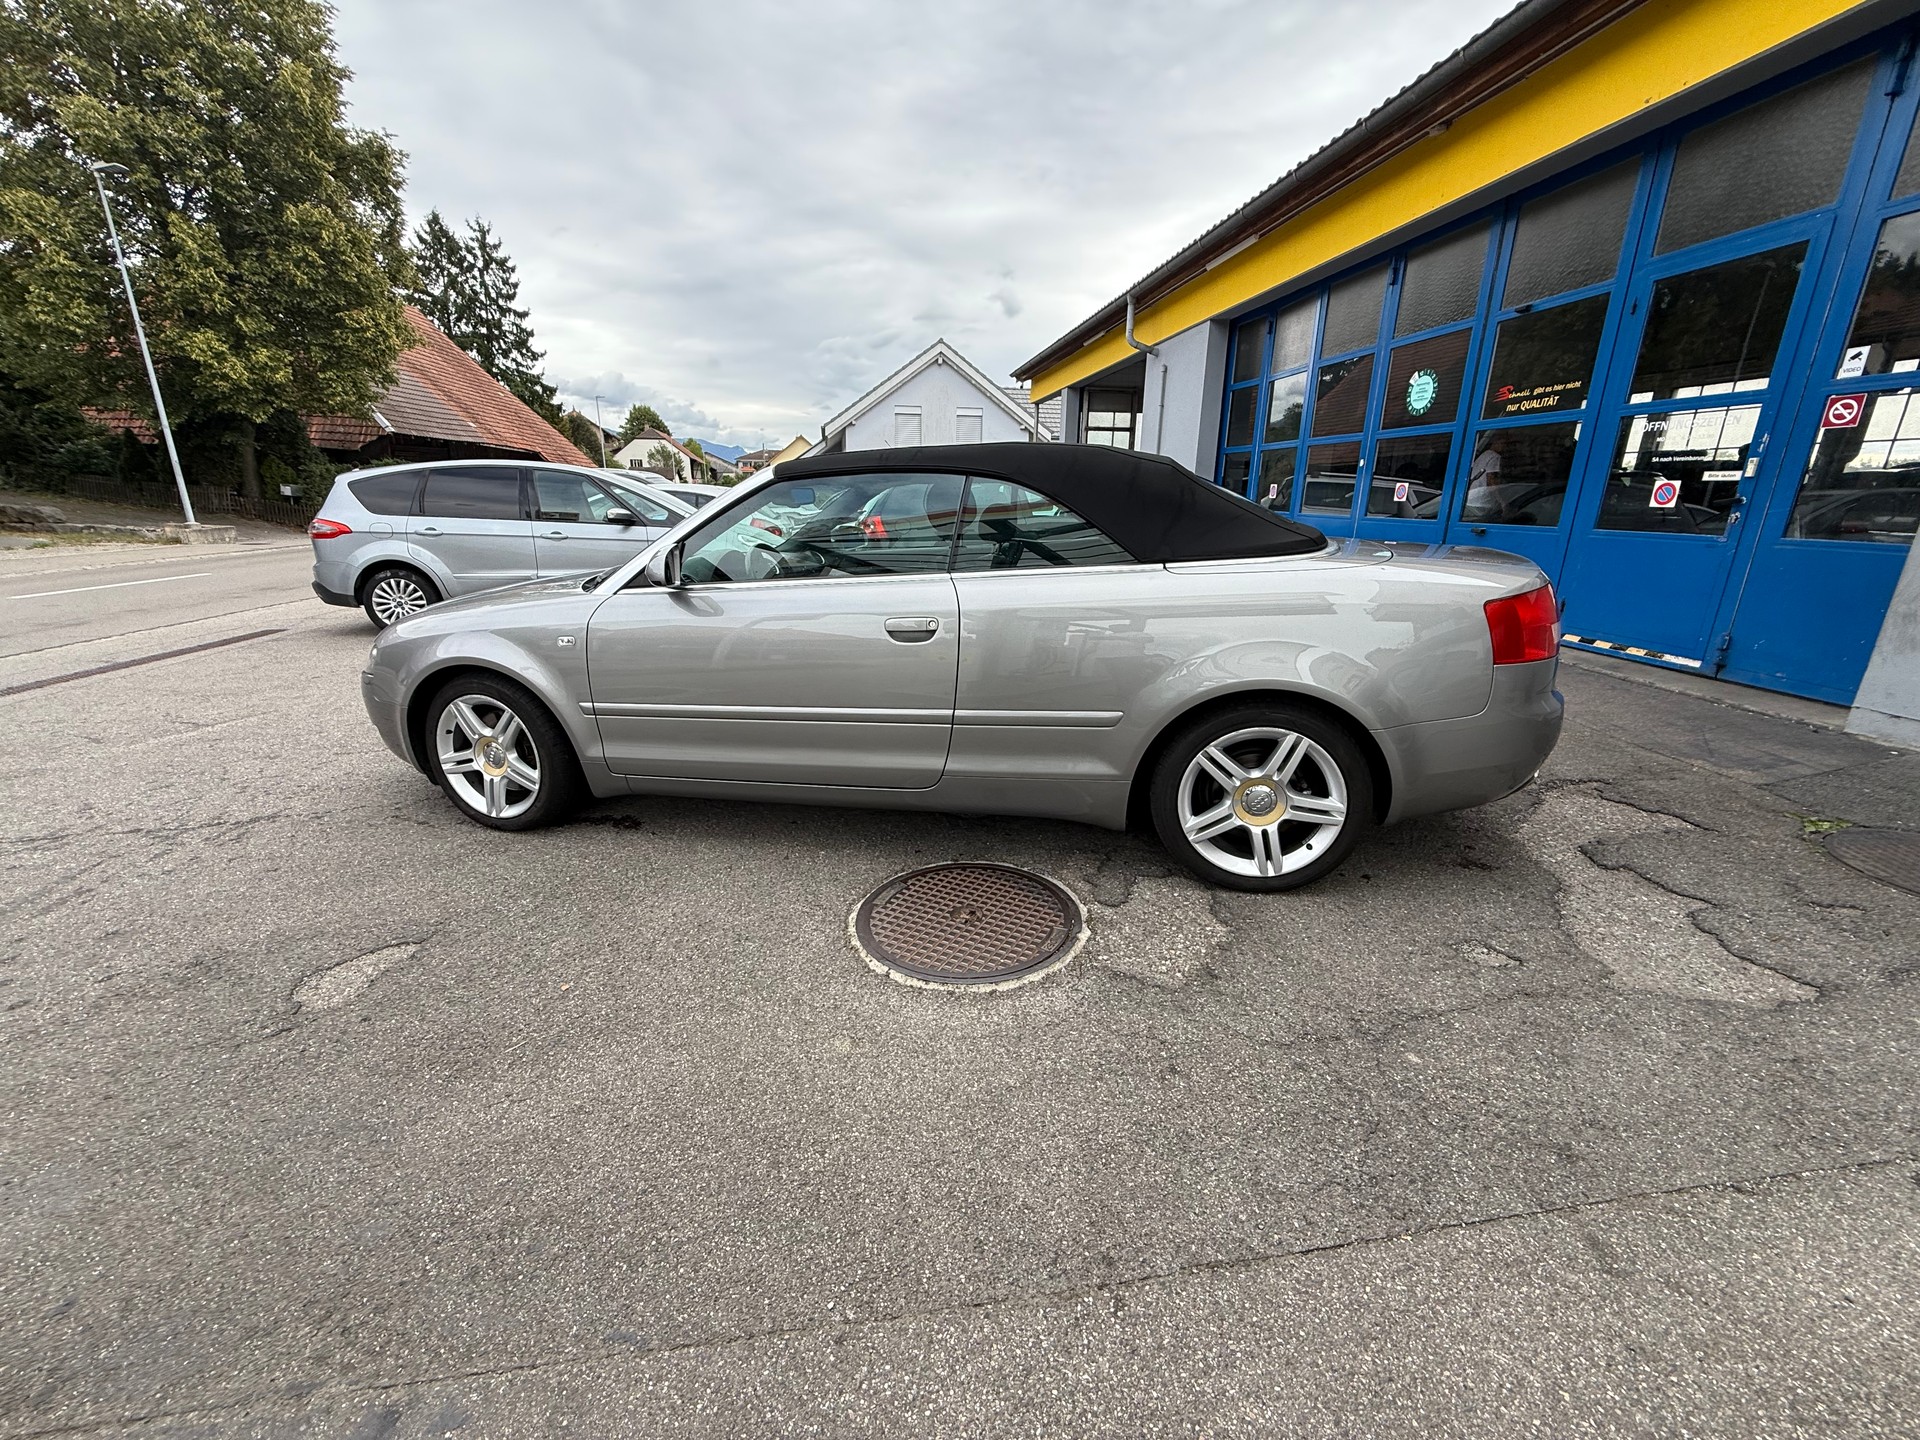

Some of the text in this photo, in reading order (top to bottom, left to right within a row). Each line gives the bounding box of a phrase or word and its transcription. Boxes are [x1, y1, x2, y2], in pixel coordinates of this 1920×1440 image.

[1493, 385, 1531, 403] Schnell
[1533, 387, 1545, 396] gibt
[1553, 382, 1566, 391] hier
[1565, 380, 1582, 389] nicht
[1506, 395, 1560, 412] nur QUALITÄT
